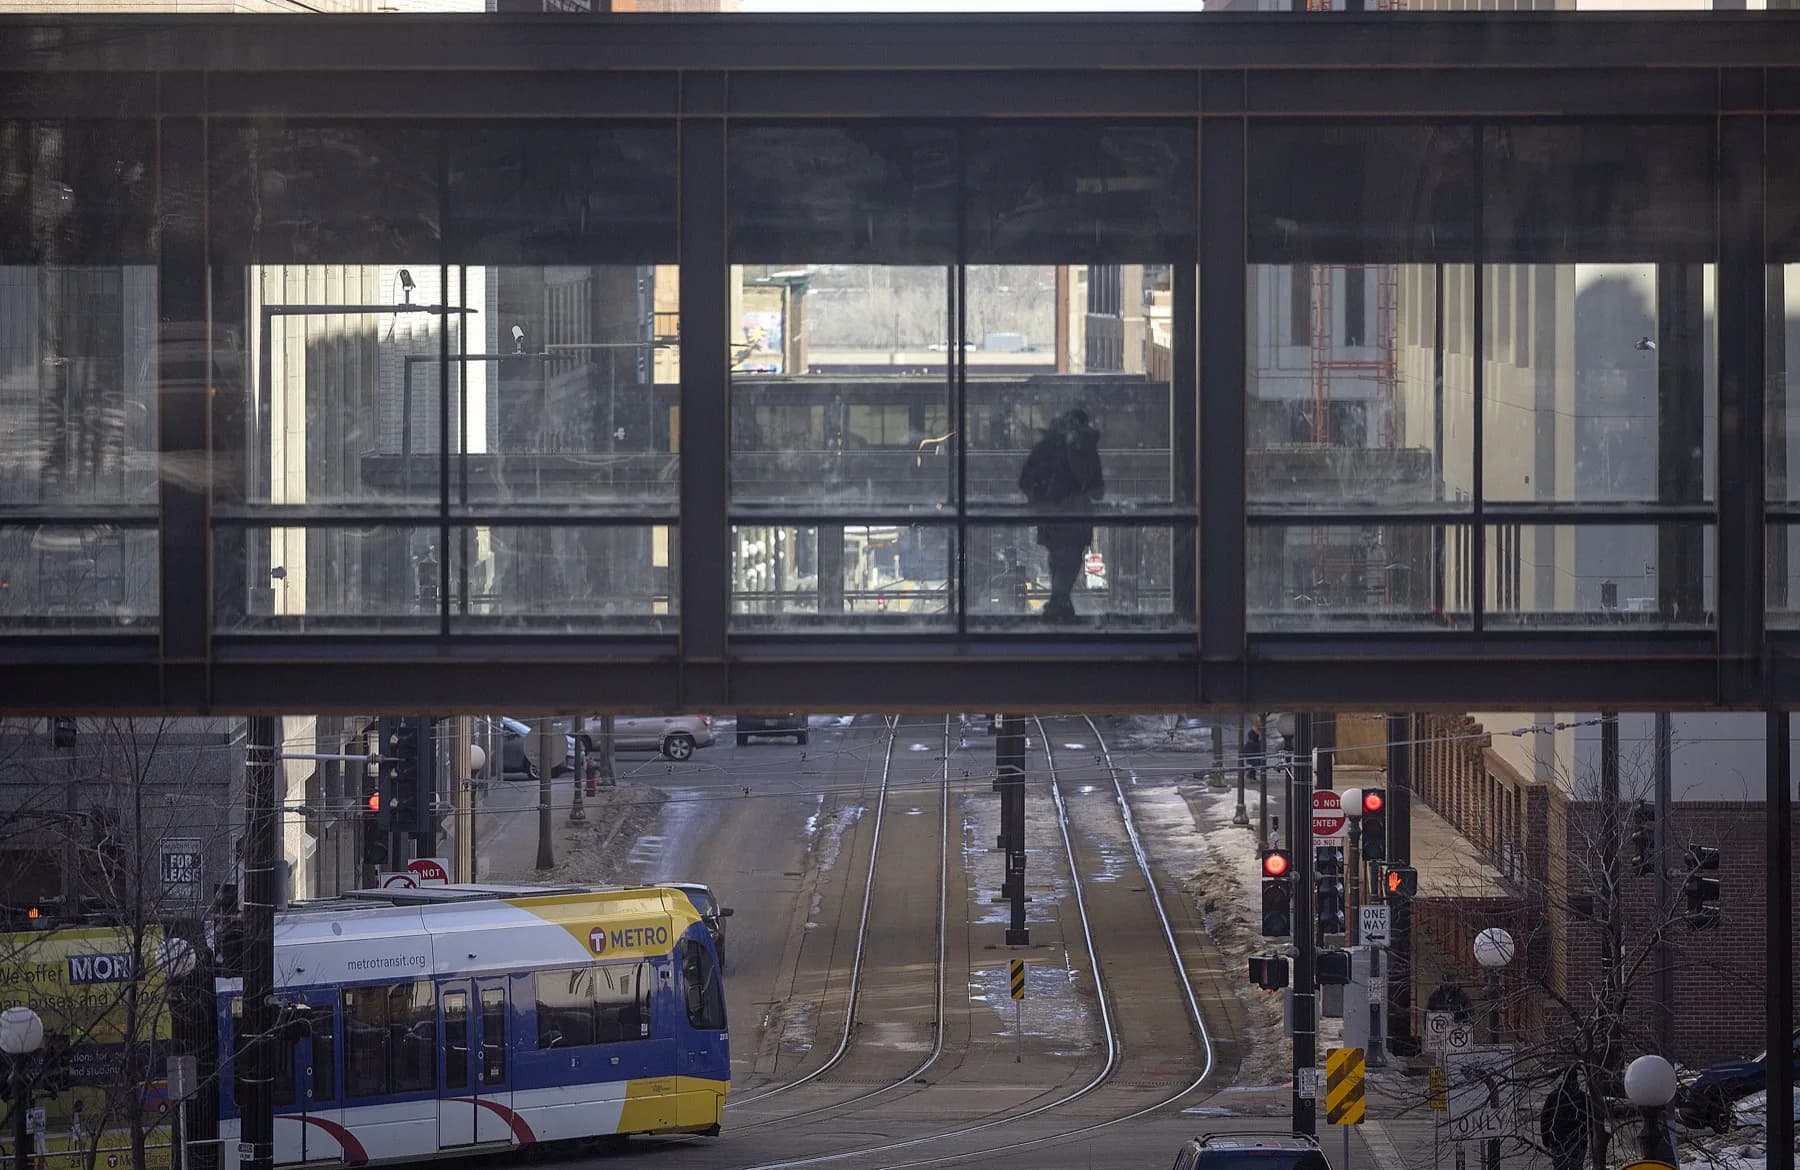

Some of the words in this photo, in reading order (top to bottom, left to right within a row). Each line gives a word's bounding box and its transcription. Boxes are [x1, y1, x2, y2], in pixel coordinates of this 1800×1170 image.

[1323, 799, 1340, 808] NOT
[170, 854, 193, 868] FOR
[422, 868, 441, 878] NOT
[1363, 908, 1386, 919] ONE
[1363, 920, 1386, 930] WAY
[611, 927, 667, 948] METRO
[26, 964, 63, 983] offer
[71, 955, 133, 981] MOR
[347, 953, 426, 971] metrotransit.org
[1458, 1114, 1505, 1133] ONLY
